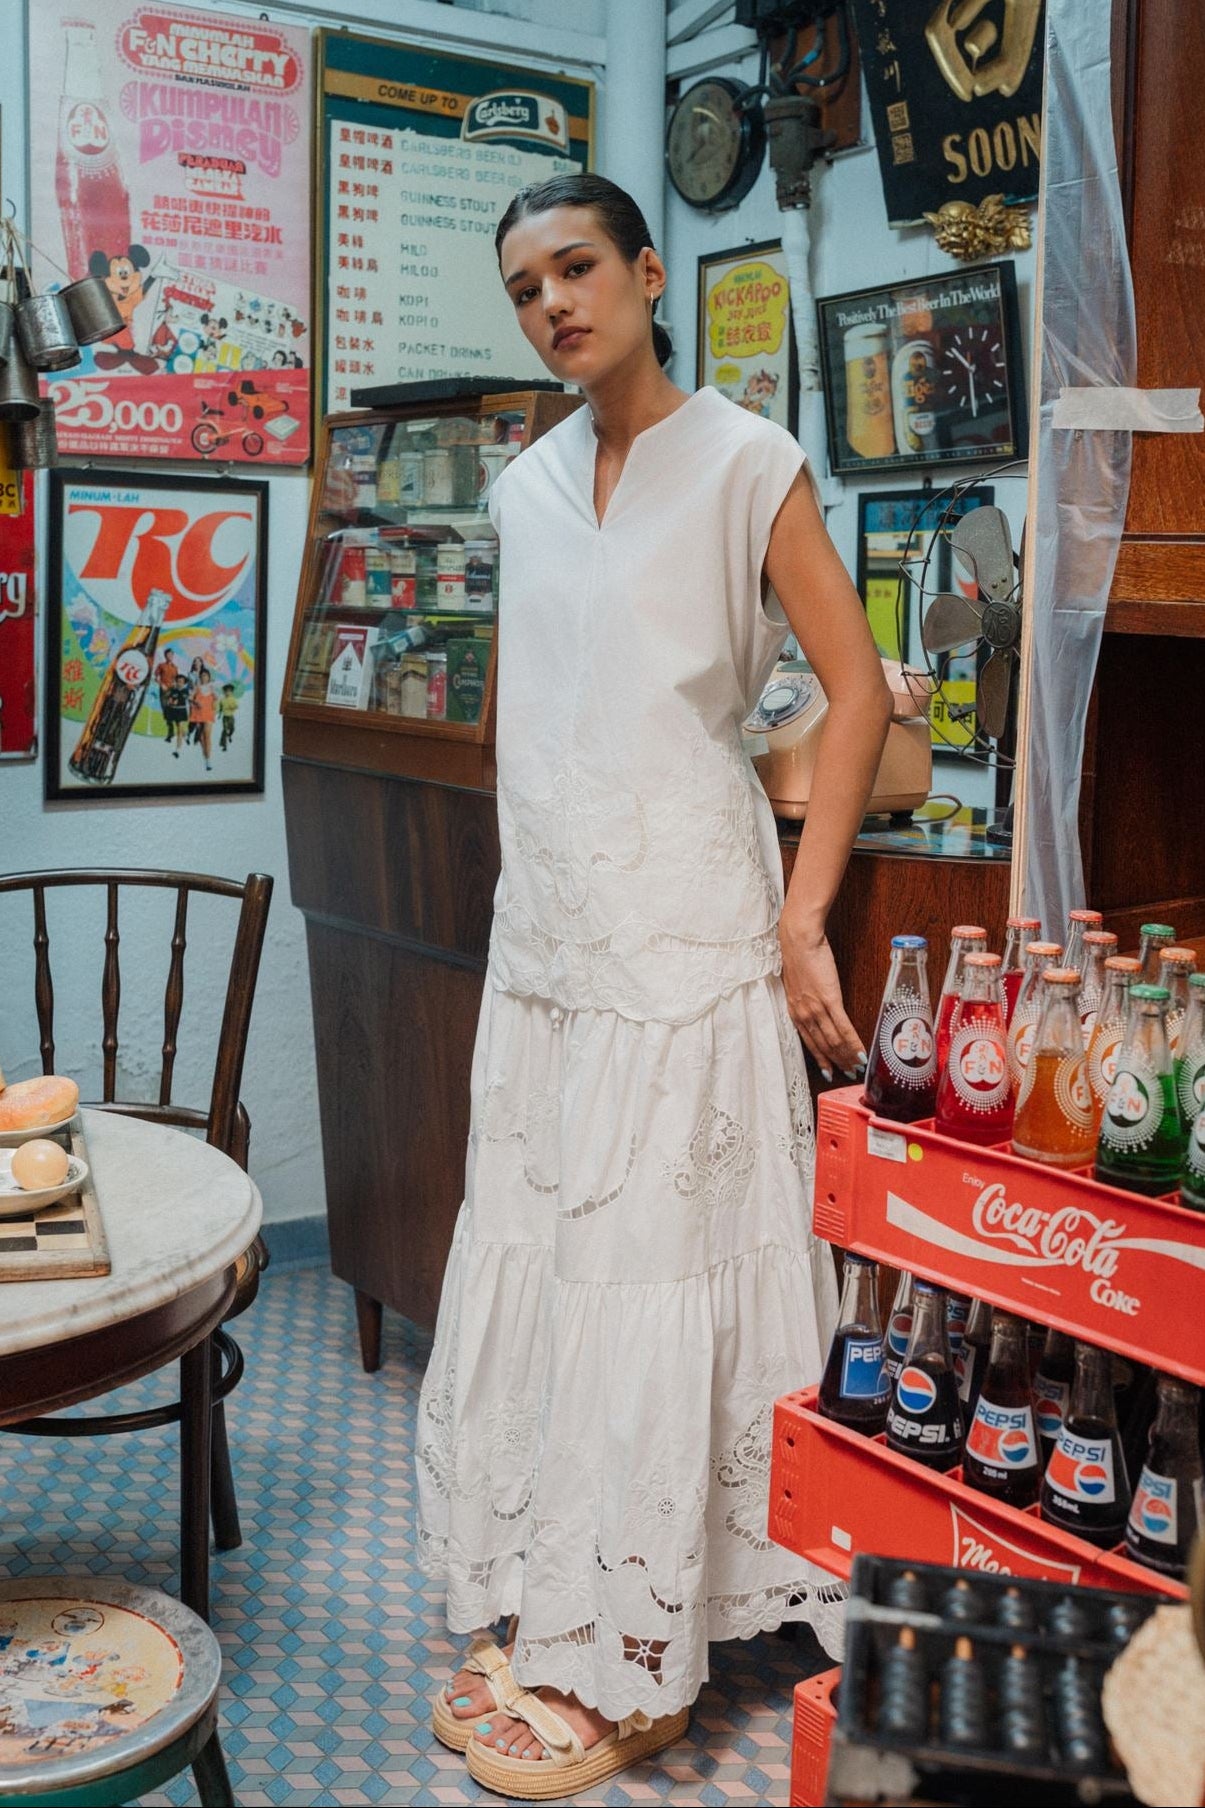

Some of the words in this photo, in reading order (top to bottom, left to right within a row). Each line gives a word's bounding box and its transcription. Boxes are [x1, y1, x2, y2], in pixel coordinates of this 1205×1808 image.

[130, 28, 176, 57] F&N
[378, 84, 417, 101] COME
[419, 91, 438, 105] UP
[441, 96, 459, 110] TO
[475, 100, 530, 126] Carlsberg
[400, 139, 471, 161] CARLSBERG
[943, 113, 1042, 185] SOON
[400, 161, 471, 181] CARLSBERG
[475, 169, 505, 184] BEER
[400, 190, 457, 208] GUINNESS
[460, 197, 497, 214] STOUT
[400, 213, 457, 231] GUINNESS
[460, 218, 498, 236] STOUT
[336, 284, 367, 301] 咖啡
[399, 294, 429, 308] KOPI
[713, 281, 781, 311] KICKAPOO
[836, 306, 877, 328] Positively
[876, 303, 895, 320] The
[939, 293, 951, 309] In
[950, 288, 971, 306] The
[968, 282, 1001, 302] World
[399, 314, 428, 327] KOPI
[398, 342, 445, 357] PACKET
[450, 347, 493, 361] DRINKS
[398, 366, 424, 379] CAN
[50, 380, 183, 434] 25,000
[68, 504, 252, 622] RC
[963, 1060, 1002, 1076] F&N
[962, 1172, 986, 1190] Enjoy
[972, 1183, 1127, 1279] Coca-Cola
[1090, 1278, 1142, 1317] Coke
[977, 1404, 1027, 1430] PEPSI
